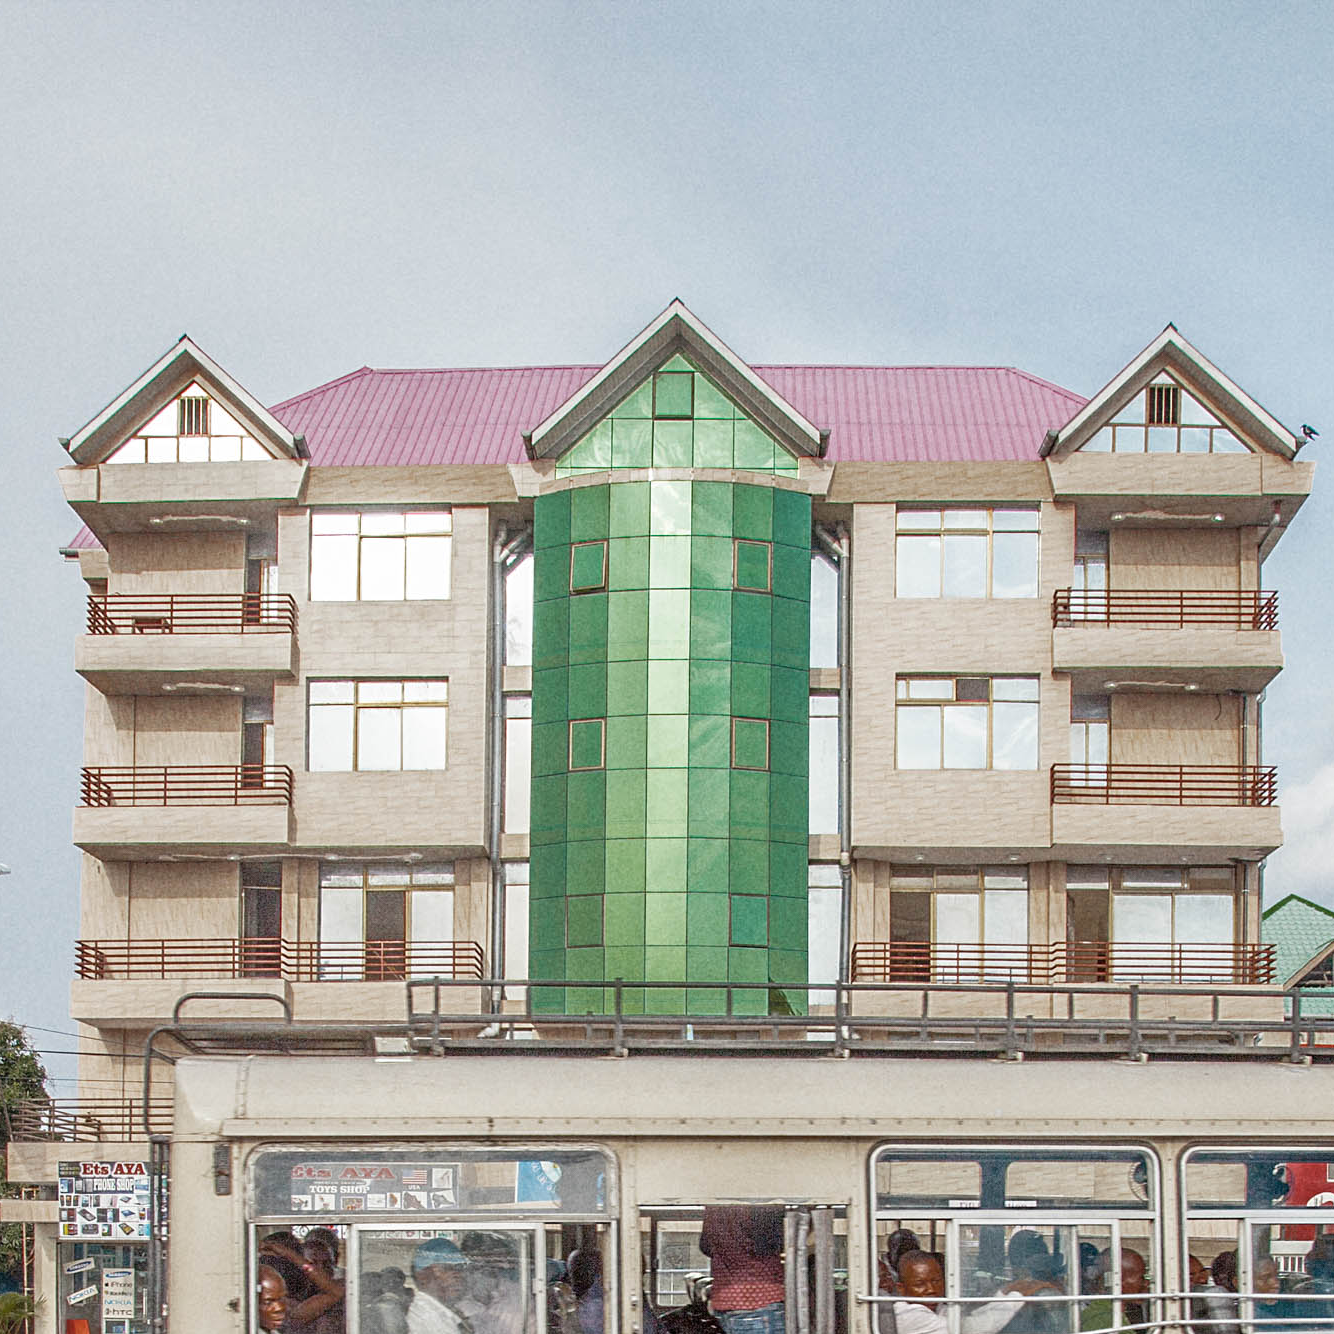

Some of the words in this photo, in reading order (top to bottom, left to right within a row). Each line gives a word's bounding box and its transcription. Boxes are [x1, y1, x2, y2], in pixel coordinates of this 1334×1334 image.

[82, 1163, 109, 1175] Ets
[114, 1163, 145, 1175] AYA
[338, 1167, 395, 1180] AYA
[93, 1178, 116, 1191] PHONE
[117, 1178, 134, 1191] SHOP
[309, 1185, 338, 1194] TOYS
[340, 1185, 370, 1194] SHOP
